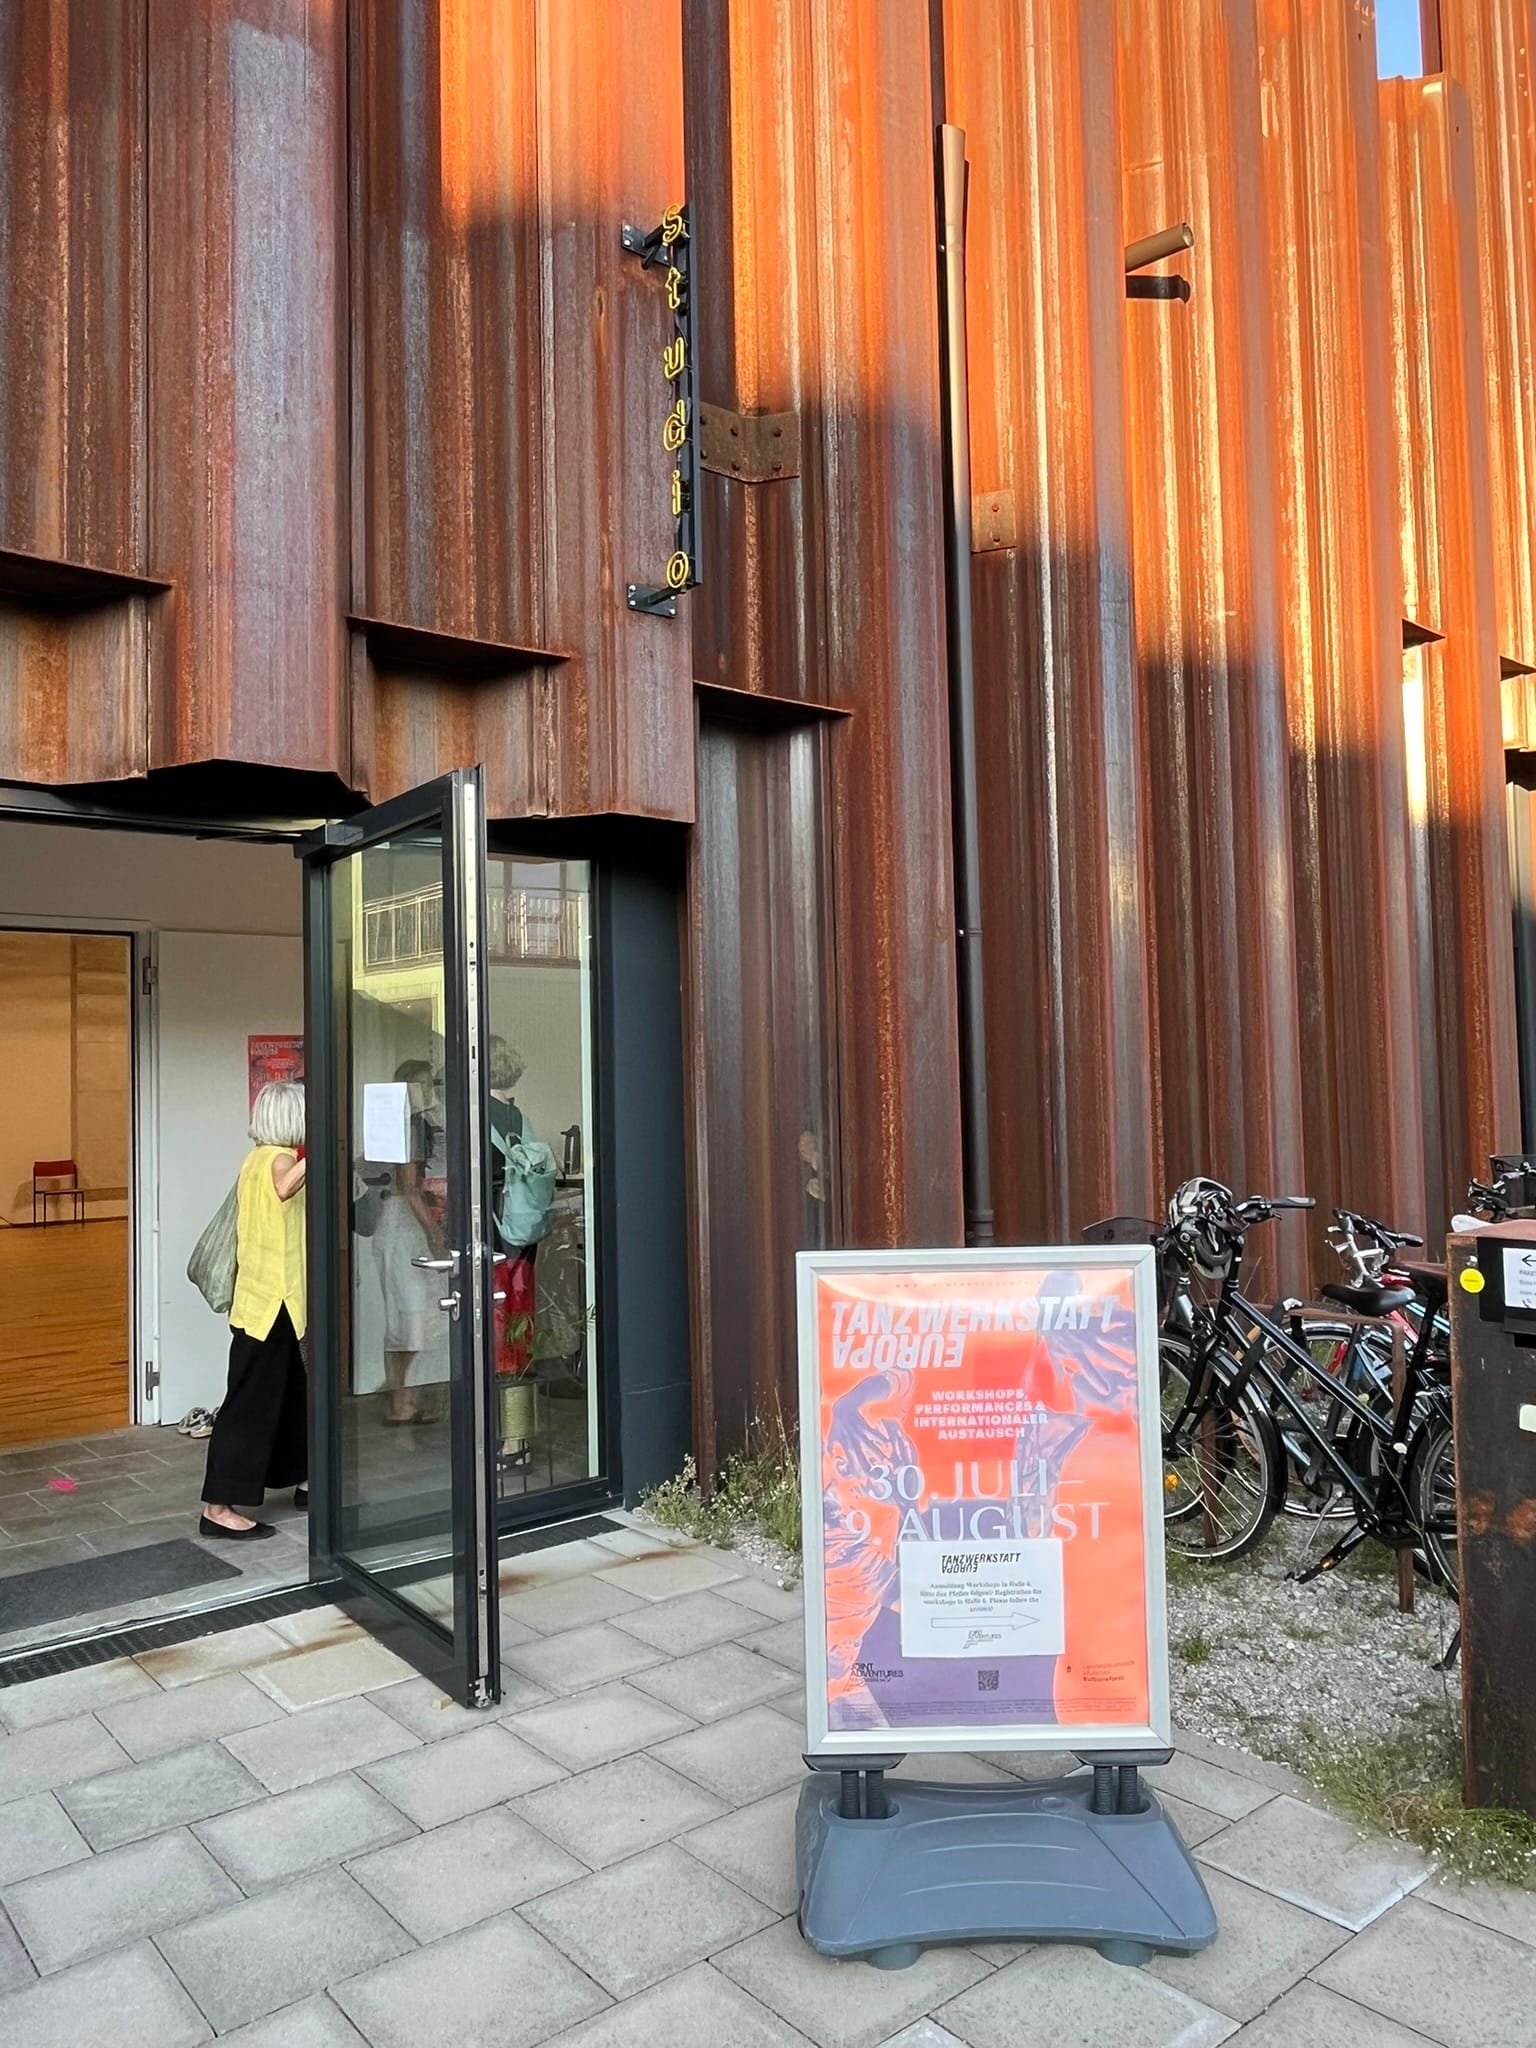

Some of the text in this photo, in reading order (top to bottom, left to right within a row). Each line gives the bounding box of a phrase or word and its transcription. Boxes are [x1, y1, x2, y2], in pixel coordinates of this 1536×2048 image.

[661, 204, 688, 589] Studio
[831, 1294, 1121, 1335] TANZWERKSTATT
[831, 1333, 968, 1369] EUROPA
[931, 1388, 1028, 1401] WORKSHOPS,
[915, 1399, 1046, 1414] PERFORMANCES &
[914, 1412, 1049, 1427] INTERNATIONALER
[938, 1427, 1026, 1440] AUSTAUSCH
[868, 1465, 939, 1501] 30.
[951, 1458, 1048, 1504] JULI
[845, 1502, 1111, 1546] 9. AUGUST
[941, 1552, 1021, 1564] TANZWERKSTATT
[941, 1561, 978, 1574] EUROPA
